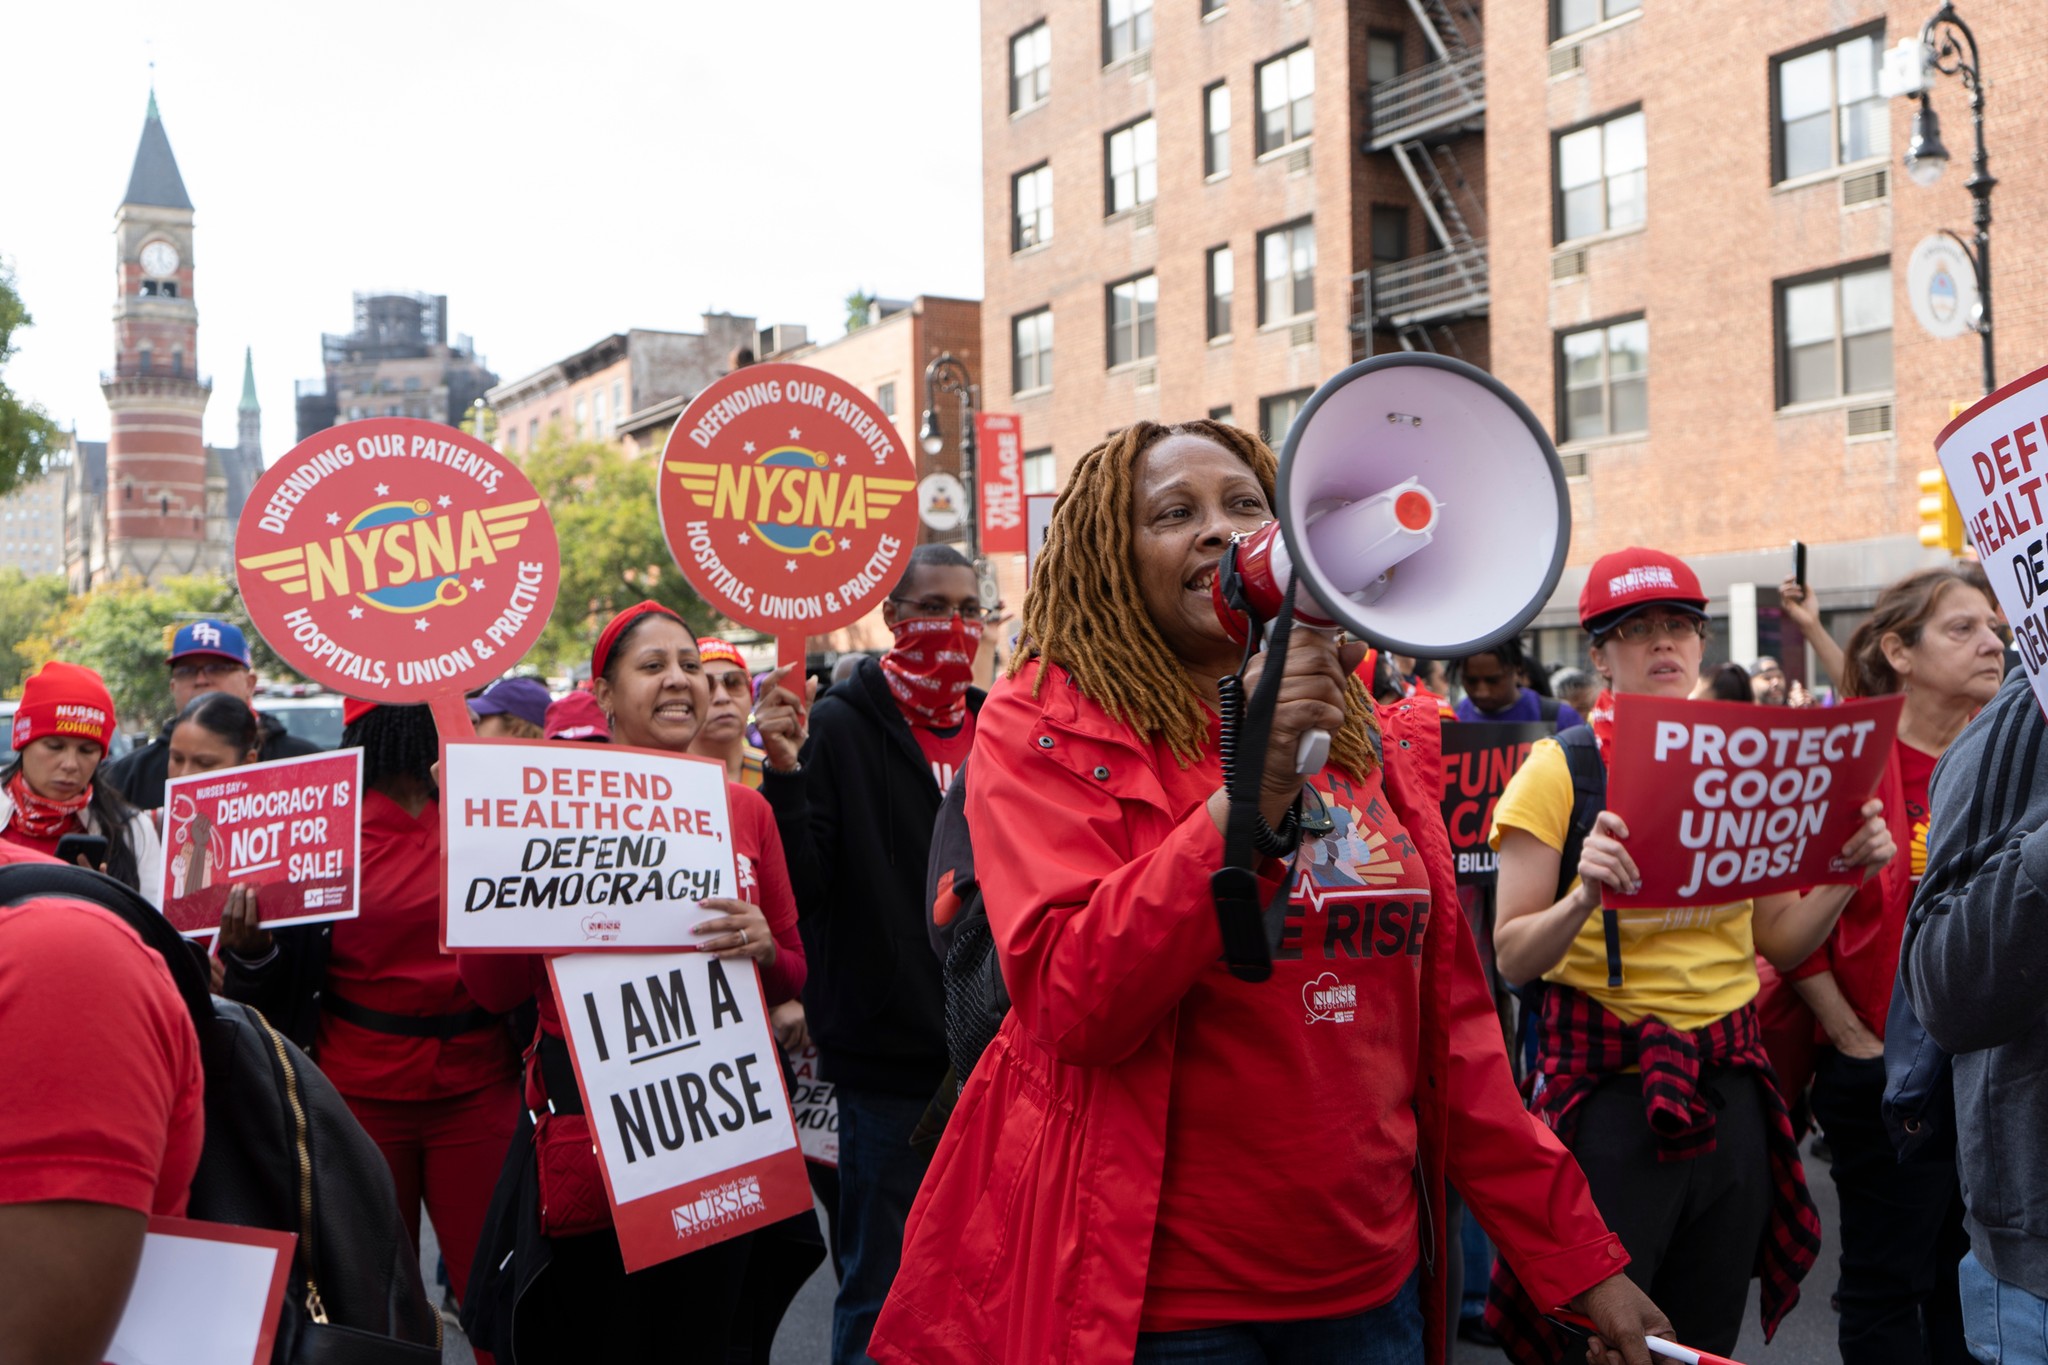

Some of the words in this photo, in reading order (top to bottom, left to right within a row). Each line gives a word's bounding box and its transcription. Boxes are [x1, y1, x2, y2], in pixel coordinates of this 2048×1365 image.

[689, 380, 782, 449] DEFENDING
[786, 380, 826, 408] OUR
[826, 392, 895, 465] PATIENTS,
[1971, 416, 2048, 497] DEF
[258, 444, 354, 534] DEFENDING
[356, 434, 406, 459] OUR
[411, 435, 504, 495] PATIENTS,
[713, 463, 867, 529] NYSNA
[1969, 473, 2048, 560] HEALT
[305, 509, 497, 602] NYSNA
[686, 521, 754, 614] HOSPITALS,
[759, 594, 823, 620] UNION
[825, 591, 842, 613] &
[839, 533, 901, 606] PRACTICE
[2012, 532, 2048, 609] DE
[283, 607, 392, 688] HOSPITALS,
[397, 647, 475, 686] UNION
[472, 637, 496, 660] &
[486, 560, 543, 647] PRACTICE
[56, 704, 106, 724] NURSES
[56, 719, 102, 738] ZOHRAN
[1654, 720, 1876, 767] PROTECT
[196, 783, 224, 800] NURSES
[226, 781, 241, 796] SAY
[217, 784, 329, 826] DEMOCRACY
[333, 780, 350, 807] IS
[523, 766, 673, 801] DEFEND
[1693, 765, 1832, 808] GOOD
[230, 822, 284, 868] NOT
[290, 816, 327, 847] FOR
[464, 798, 722, 843] HEALTHCARE,
[1679, 800, 1829, 849] UNION
[288, 849, 343, 883] SALE!
[520, 834, 667, 872] DEFEND
[1677, 836, 1807, 898] JOBS!
[464, 868, 720, 913] DEMOCRACY!
[1323, 901, 1431, 960] RISE
[583, 992, 610, 1062] I
[620, 969, 697, 1055] AM
[707, 958, 743, 1030] A
[1314, 989, 1356, 1005] NURSES
[610, 1053, 773, 1164] NURSE
[671, 1182, 761, 1231] NURSES
[700, 1187, 720, 1199] New
[719, 1180, 738, 1194] York
[738, 1175, 757, 1187] State
[677, 1198, 766, 1240] ASSOCIATION
